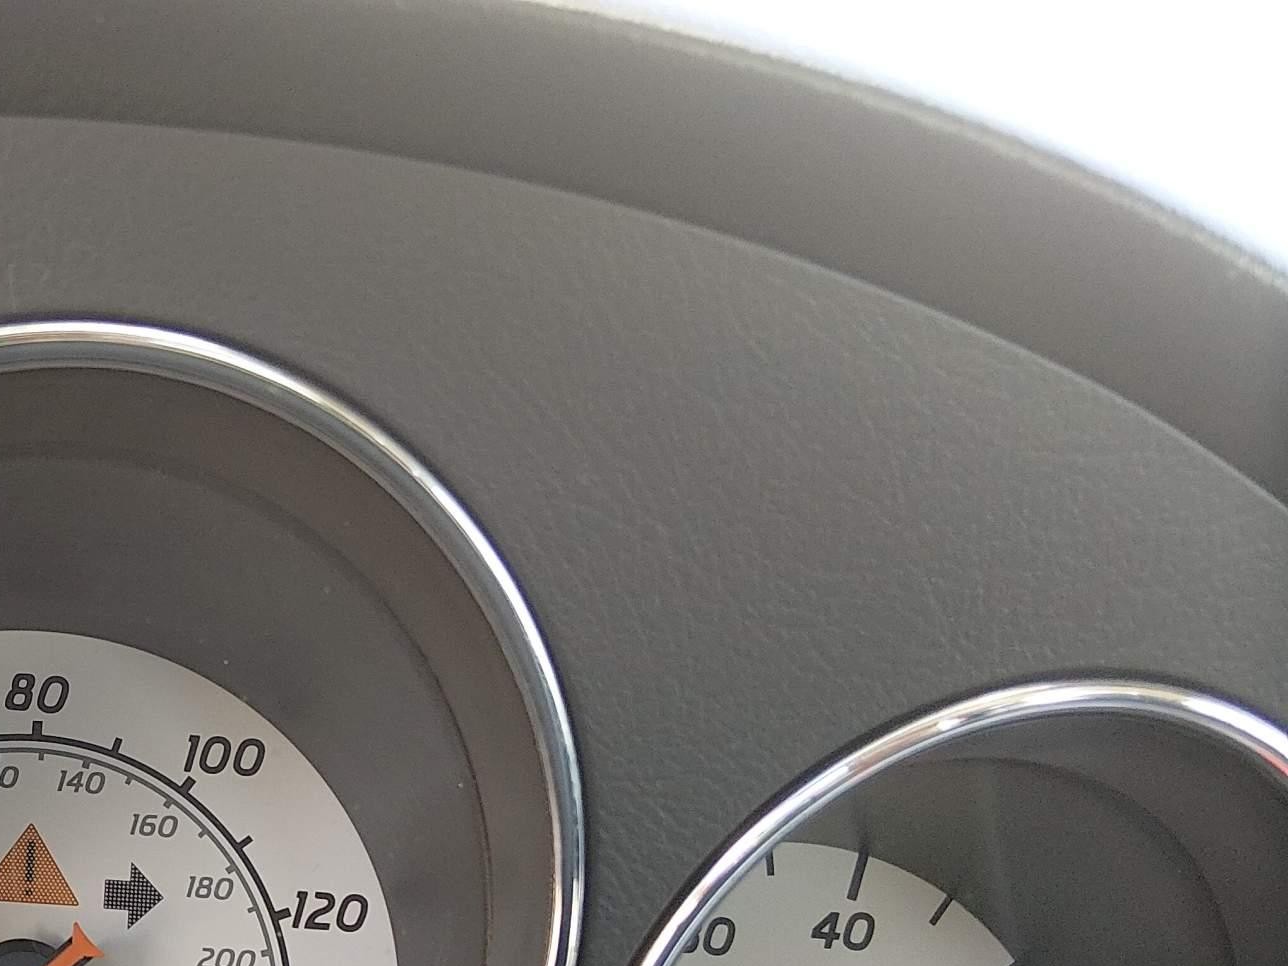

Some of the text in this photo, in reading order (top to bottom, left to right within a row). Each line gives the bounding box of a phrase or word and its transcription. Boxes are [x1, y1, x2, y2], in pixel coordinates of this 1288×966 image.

[5, 673, 69, 714] 80
[184, 735, 265, 776] 100
[57, 770, 106, 794] 140
[130, 814, 178, 838] 160
[186, 876, 234, 900] 180
[292, 890, 369, 932] 120
[811, 911, 875, 950] 40
